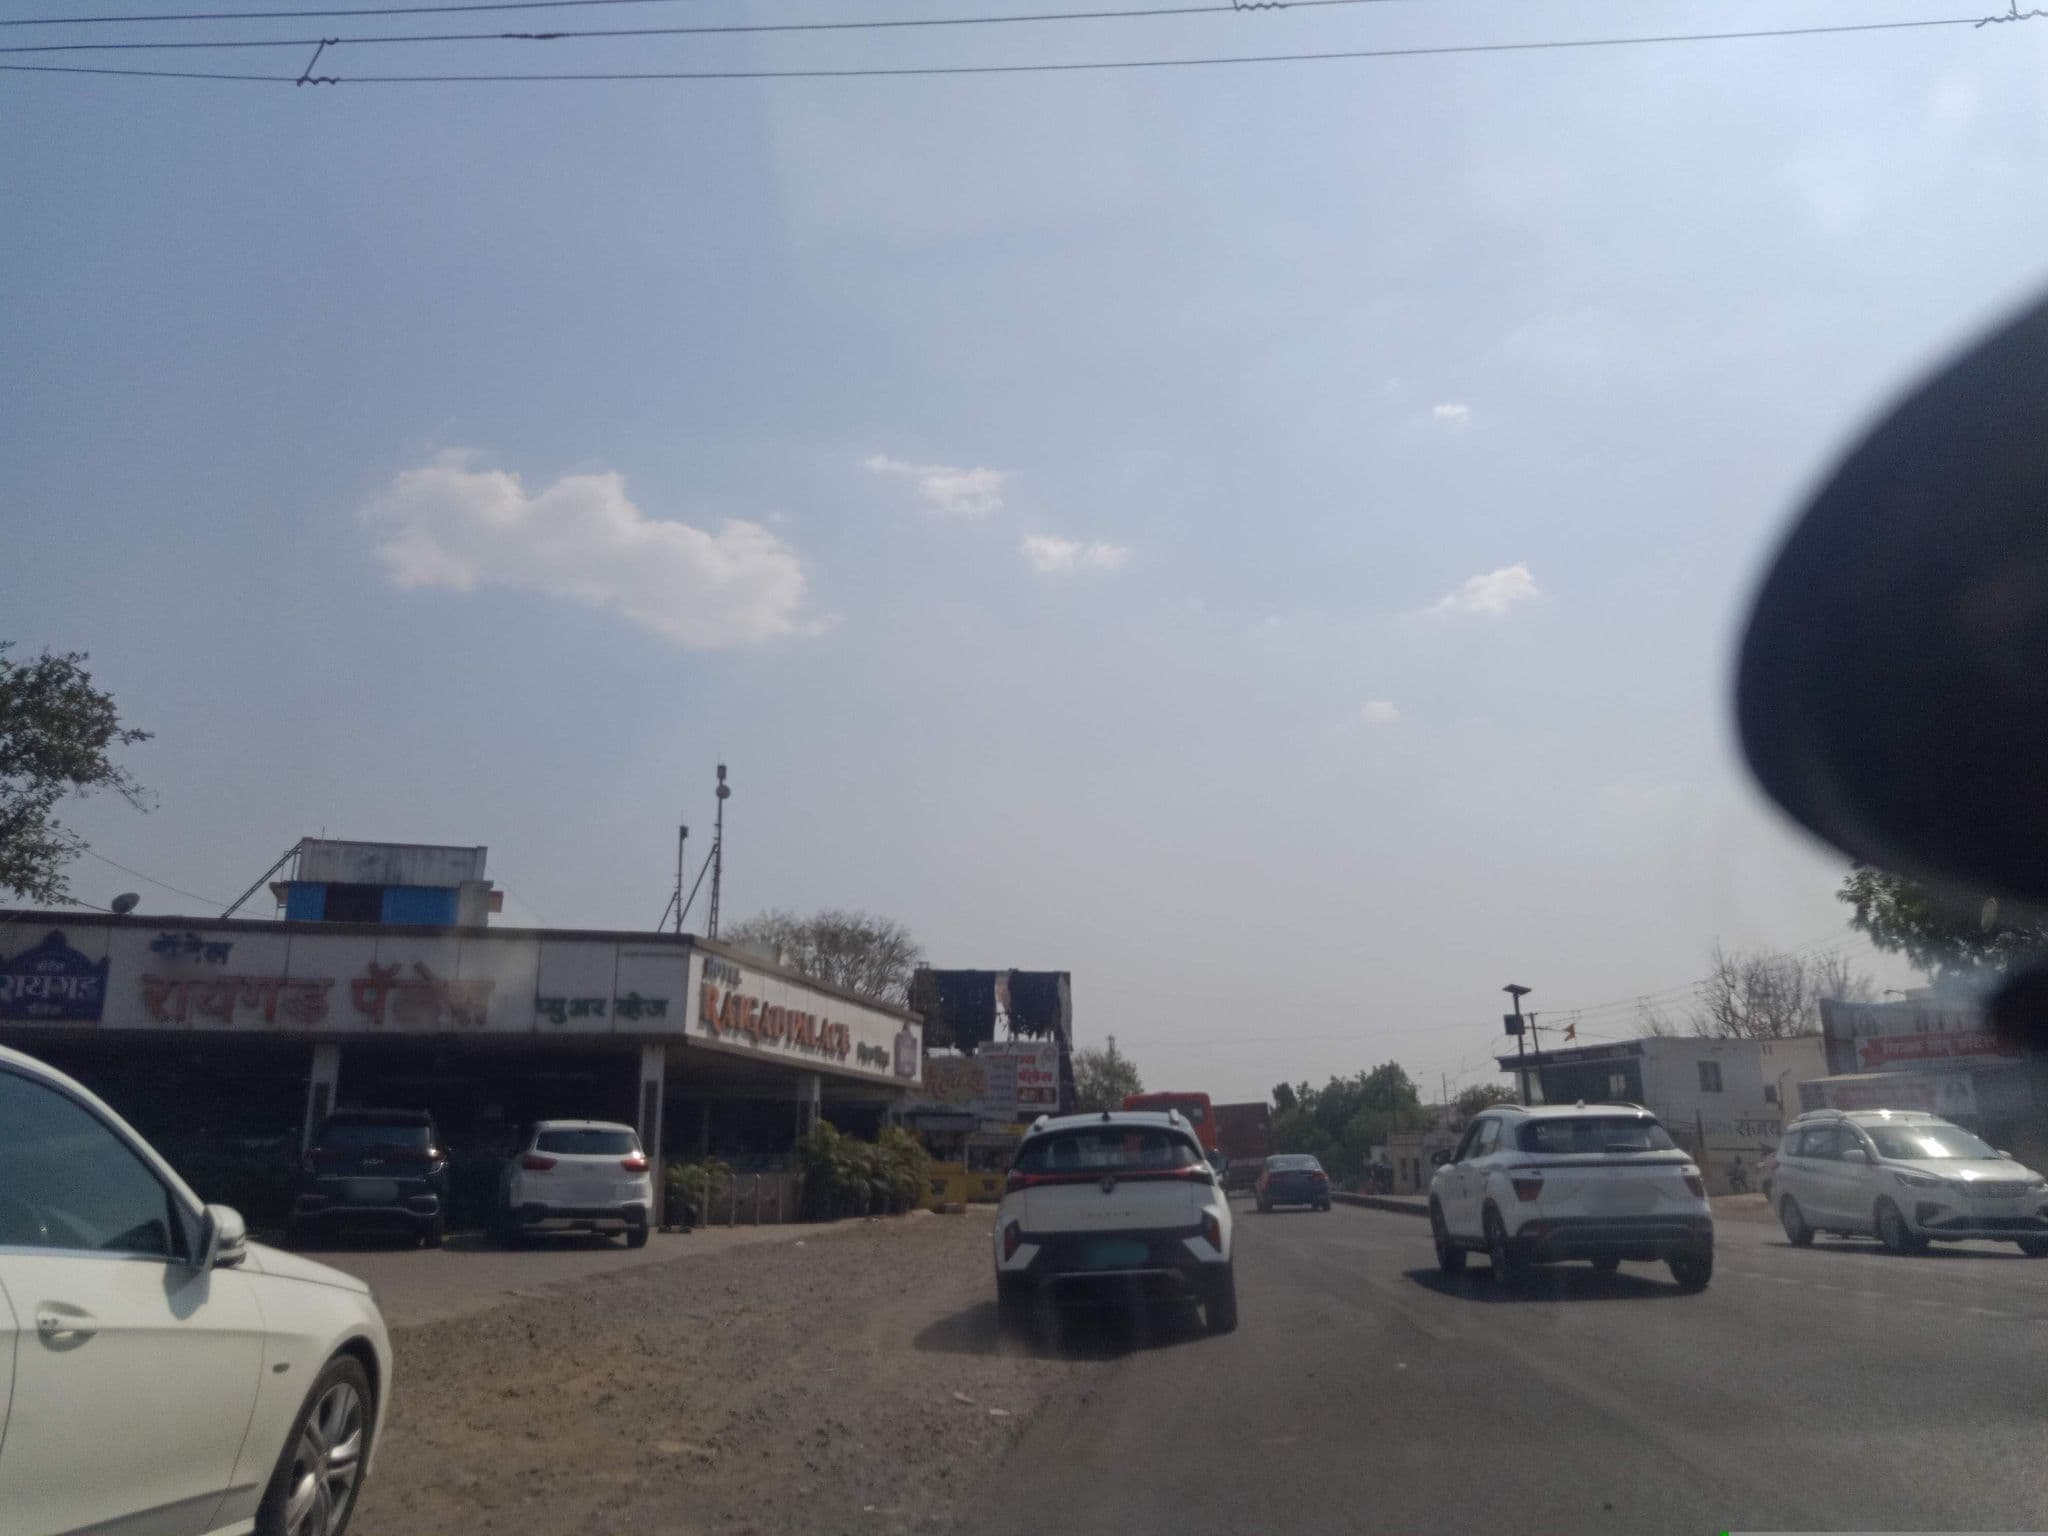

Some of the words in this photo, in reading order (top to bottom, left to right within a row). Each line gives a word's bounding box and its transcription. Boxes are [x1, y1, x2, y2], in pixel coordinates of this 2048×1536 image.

[141, 974, 336, 1024] रायगड
[699, 983, 785, 1042] RAIGAD
[785, 1008, 851, 1060] PALACE
